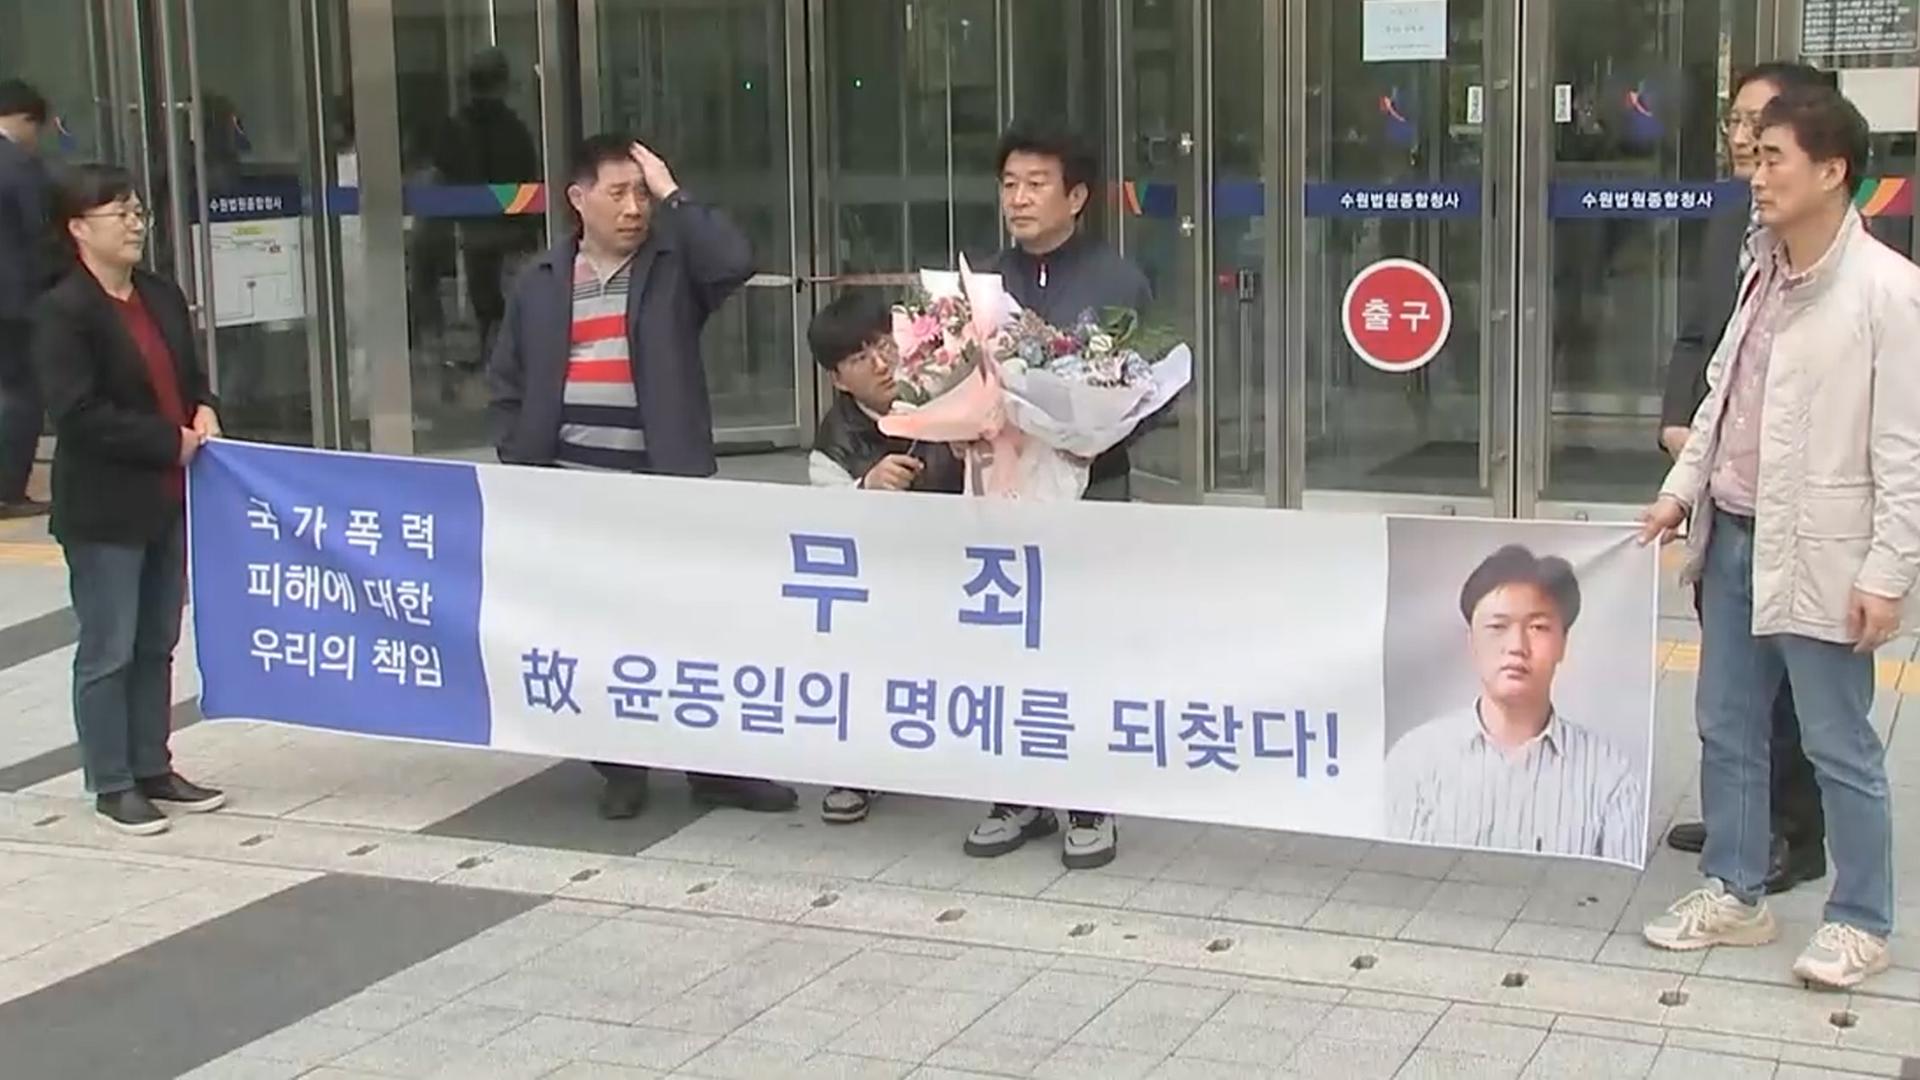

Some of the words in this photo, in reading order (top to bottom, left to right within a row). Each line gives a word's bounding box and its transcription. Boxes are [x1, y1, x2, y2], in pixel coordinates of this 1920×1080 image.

[1340, 191, 1460, 209] 수원법원종합청사
[1581, 191, 1713, 209] 수원법원종합청사
[247, 562, 356, 614] 피해에
[362, 578, 434, 626] 대한
[250, 628, 356, 682] 우리의
[371, 638, 443, 687] 책임
[521, 647, 582, 716] 故
[606, 653, 850, 742] 윤동일의
[885, 677, 1075, 761] 명예를
[1108, 698, 1341, 779] 되찾다!
